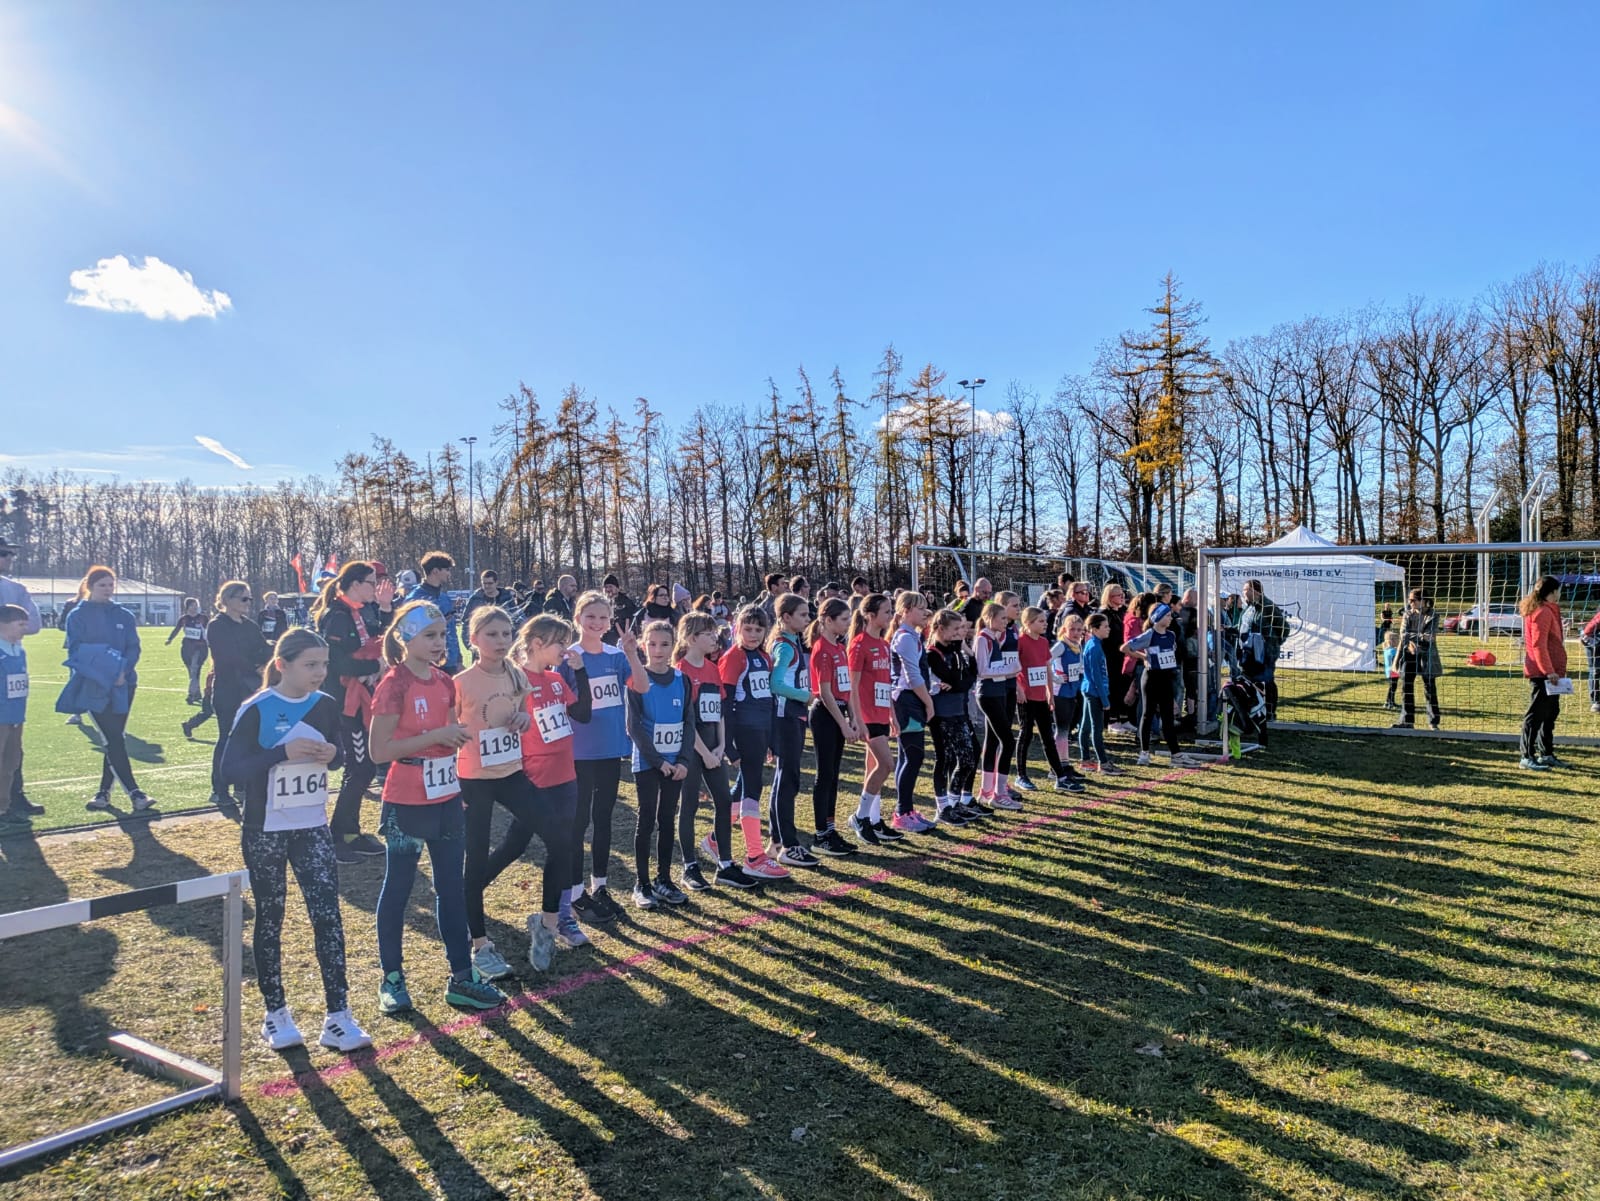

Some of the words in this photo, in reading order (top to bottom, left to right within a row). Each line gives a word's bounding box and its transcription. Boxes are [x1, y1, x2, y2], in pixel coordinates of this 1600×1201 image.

[1222, 569, 1235, 577] SG
[1303, 569, 1323, 577] 1861
[1326, 569, 1343, 577] e.V.
[593, 683, 619, 700] 040
[480, 732, 520, 756] 1198
[276, 773, 327, 796] 1164
